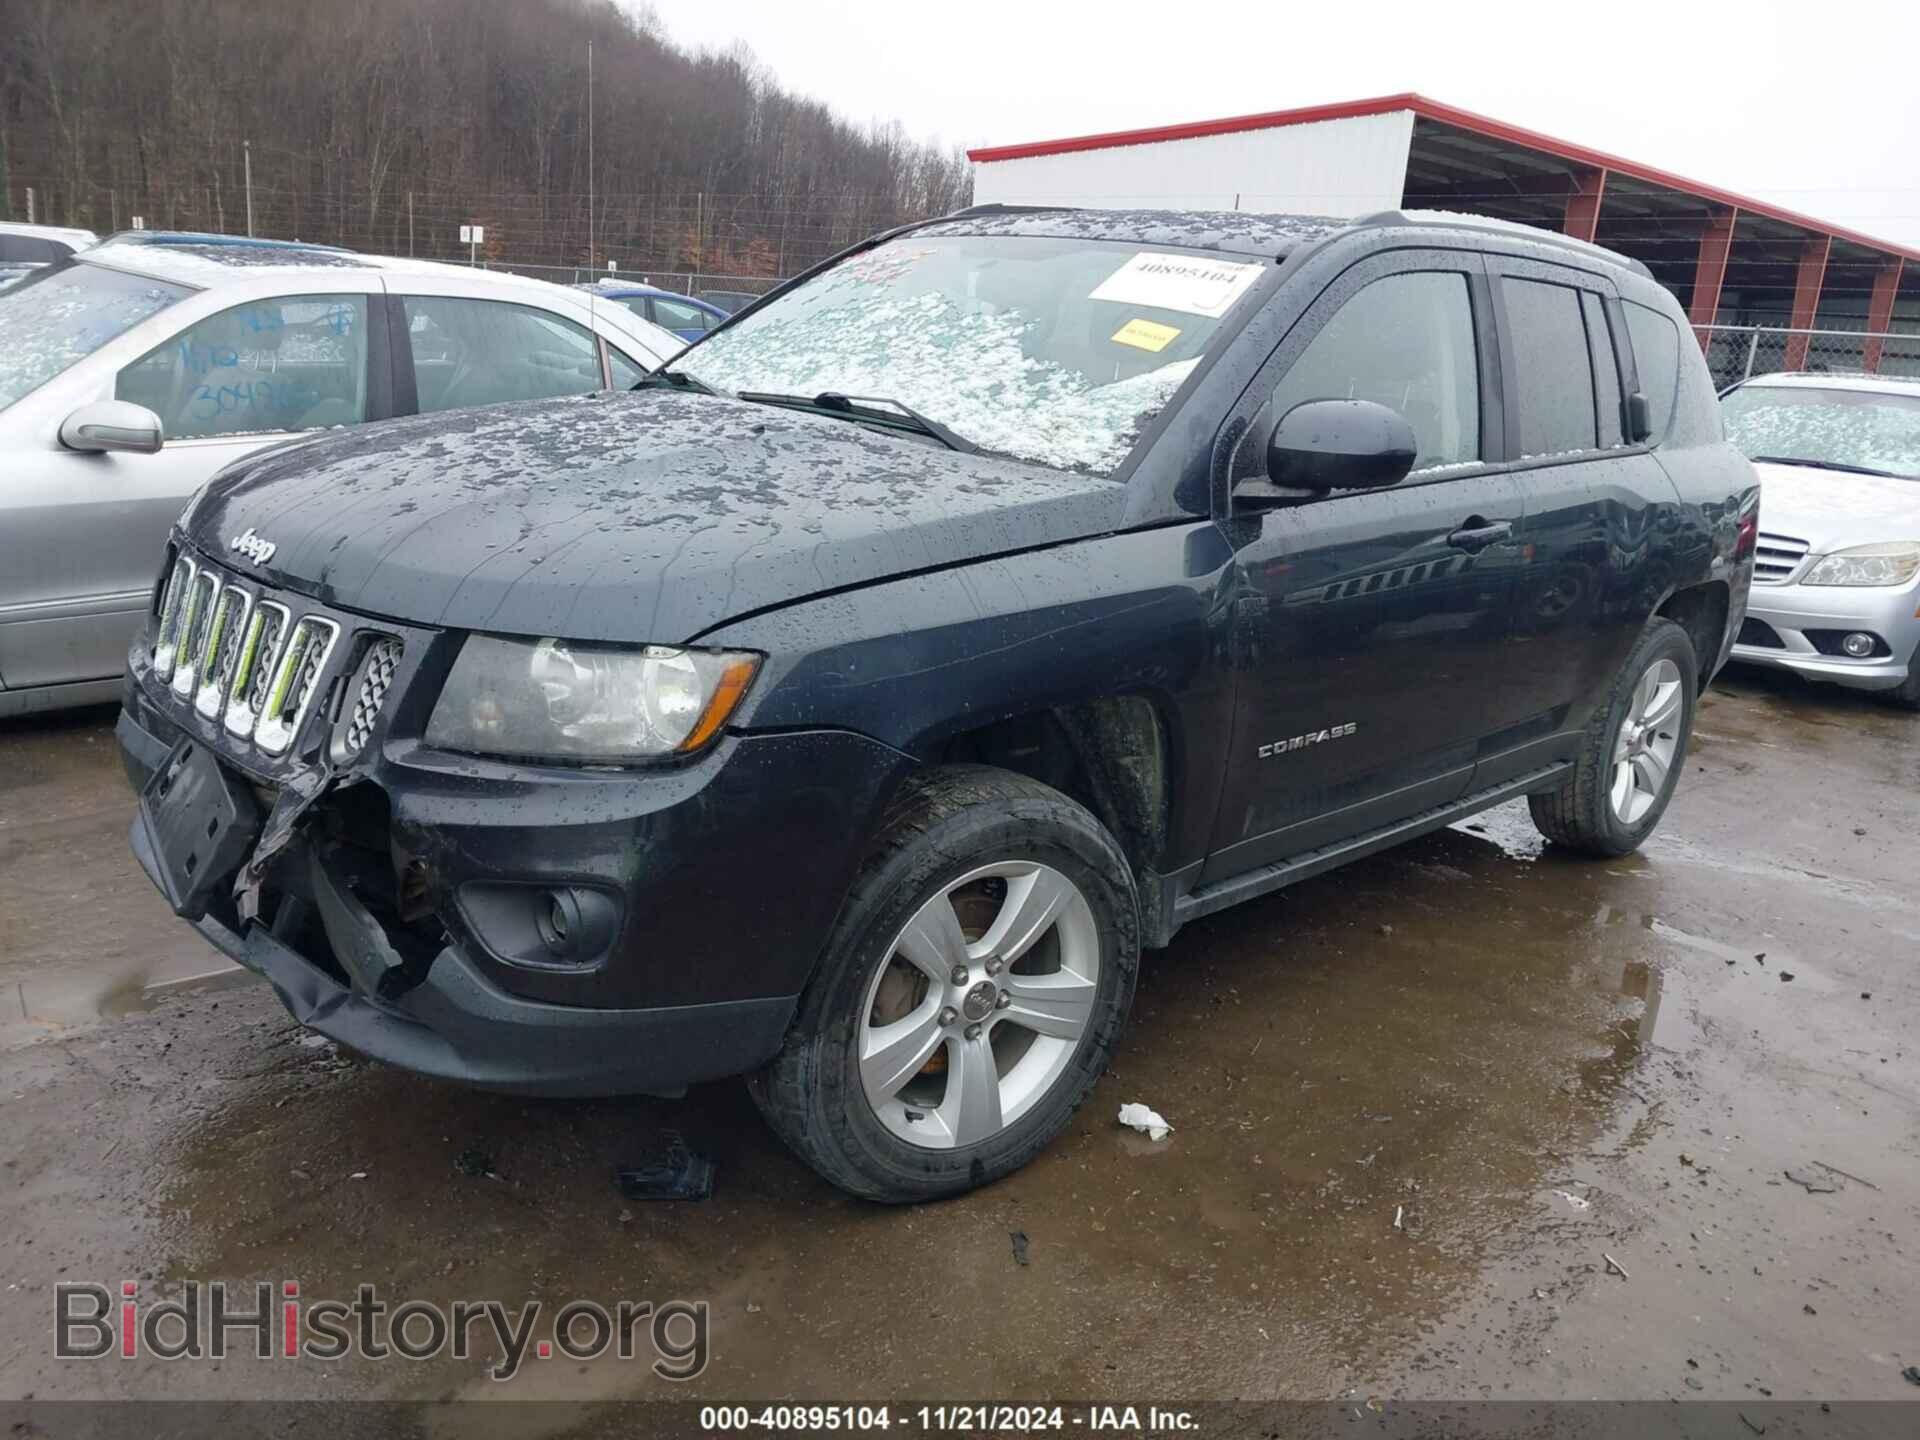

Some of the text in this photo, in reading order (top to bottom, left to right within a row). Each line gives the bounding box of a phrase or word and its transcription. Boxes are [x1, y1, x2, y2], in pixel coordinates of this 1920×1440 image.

[1136, 262, 1239, 284] 40895104
[231, 527, 277, 566] Jeep
[1258, 721, 1358, 759] COMPASS
